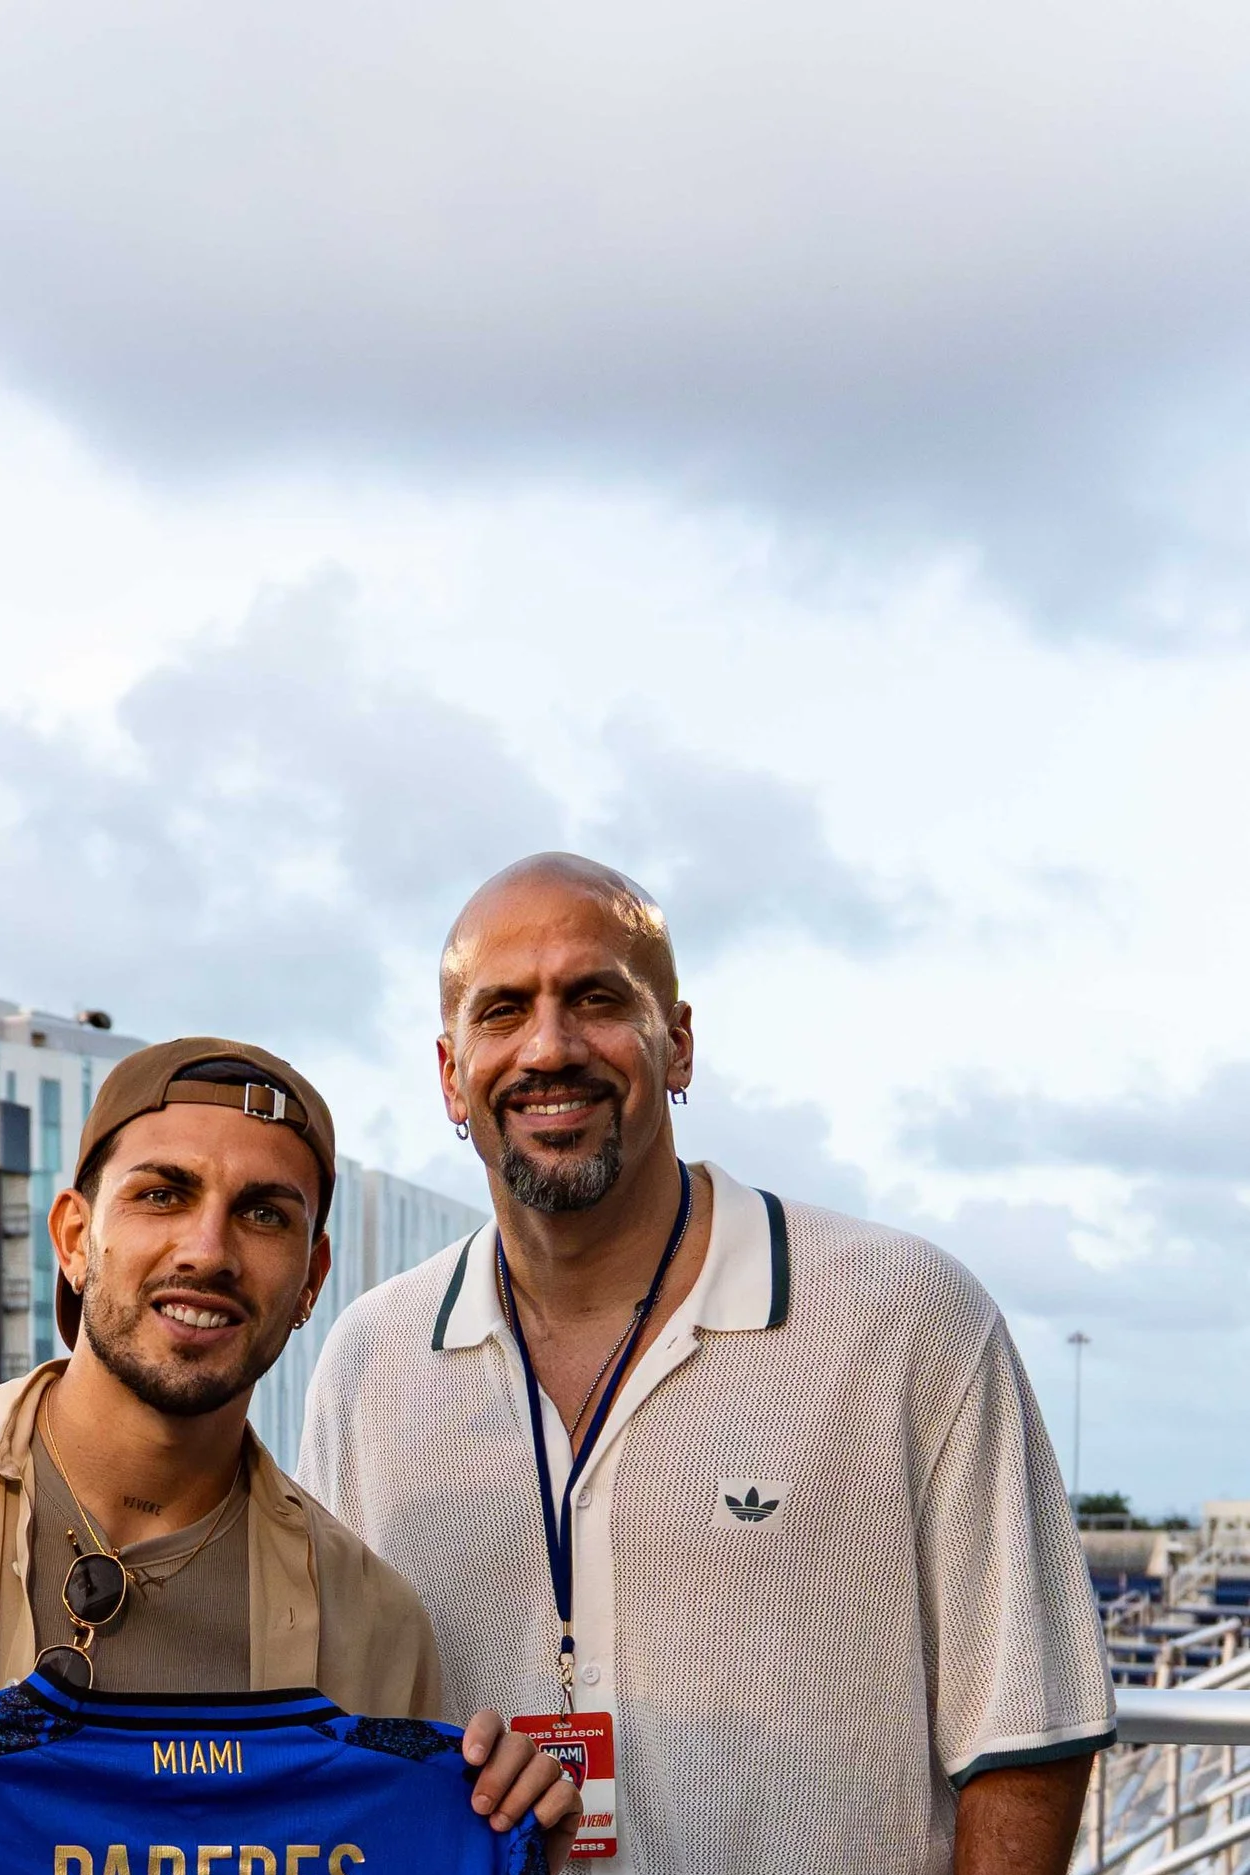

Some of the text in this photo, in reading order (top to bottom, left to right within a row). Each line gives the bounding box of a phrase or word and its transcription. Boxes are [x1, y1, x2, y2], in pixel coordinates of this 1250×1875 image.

[525, 1729, 604, 1740] 025 SEASON
[152, 1739, 243, 1774] MIAMI
